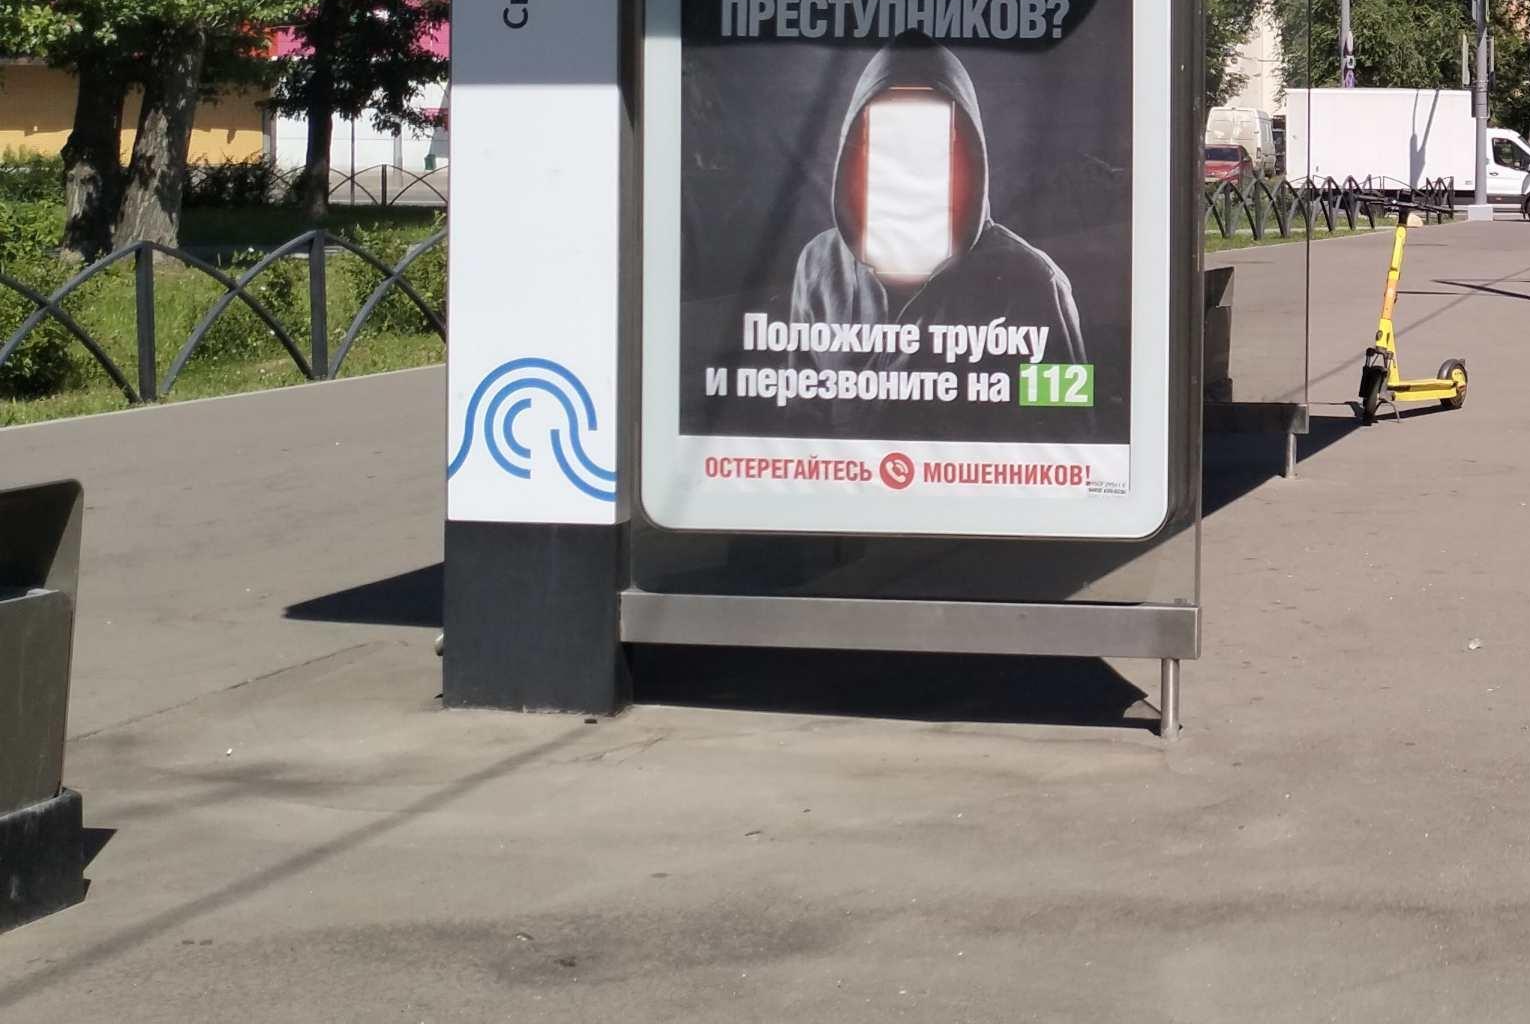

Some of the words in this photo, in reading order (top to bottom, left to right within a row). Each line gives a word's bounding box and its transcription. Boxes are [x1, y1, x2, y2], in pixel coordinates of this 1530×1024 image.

[743, 311, 921, 353] Положите
[928, 317, 1050, 363] трубку
[705, 367, 728, 397] и
[737, 368, 959, 406] перезвоните
[967, 372, 1011, 402] на
[1022, 365, 1089, 404] 112
[704, 454, 872, 483] ОСТЕРЕГАЙТЕСЬ
[923, 462, 1092, 487] МОШЕННИКОВ!
